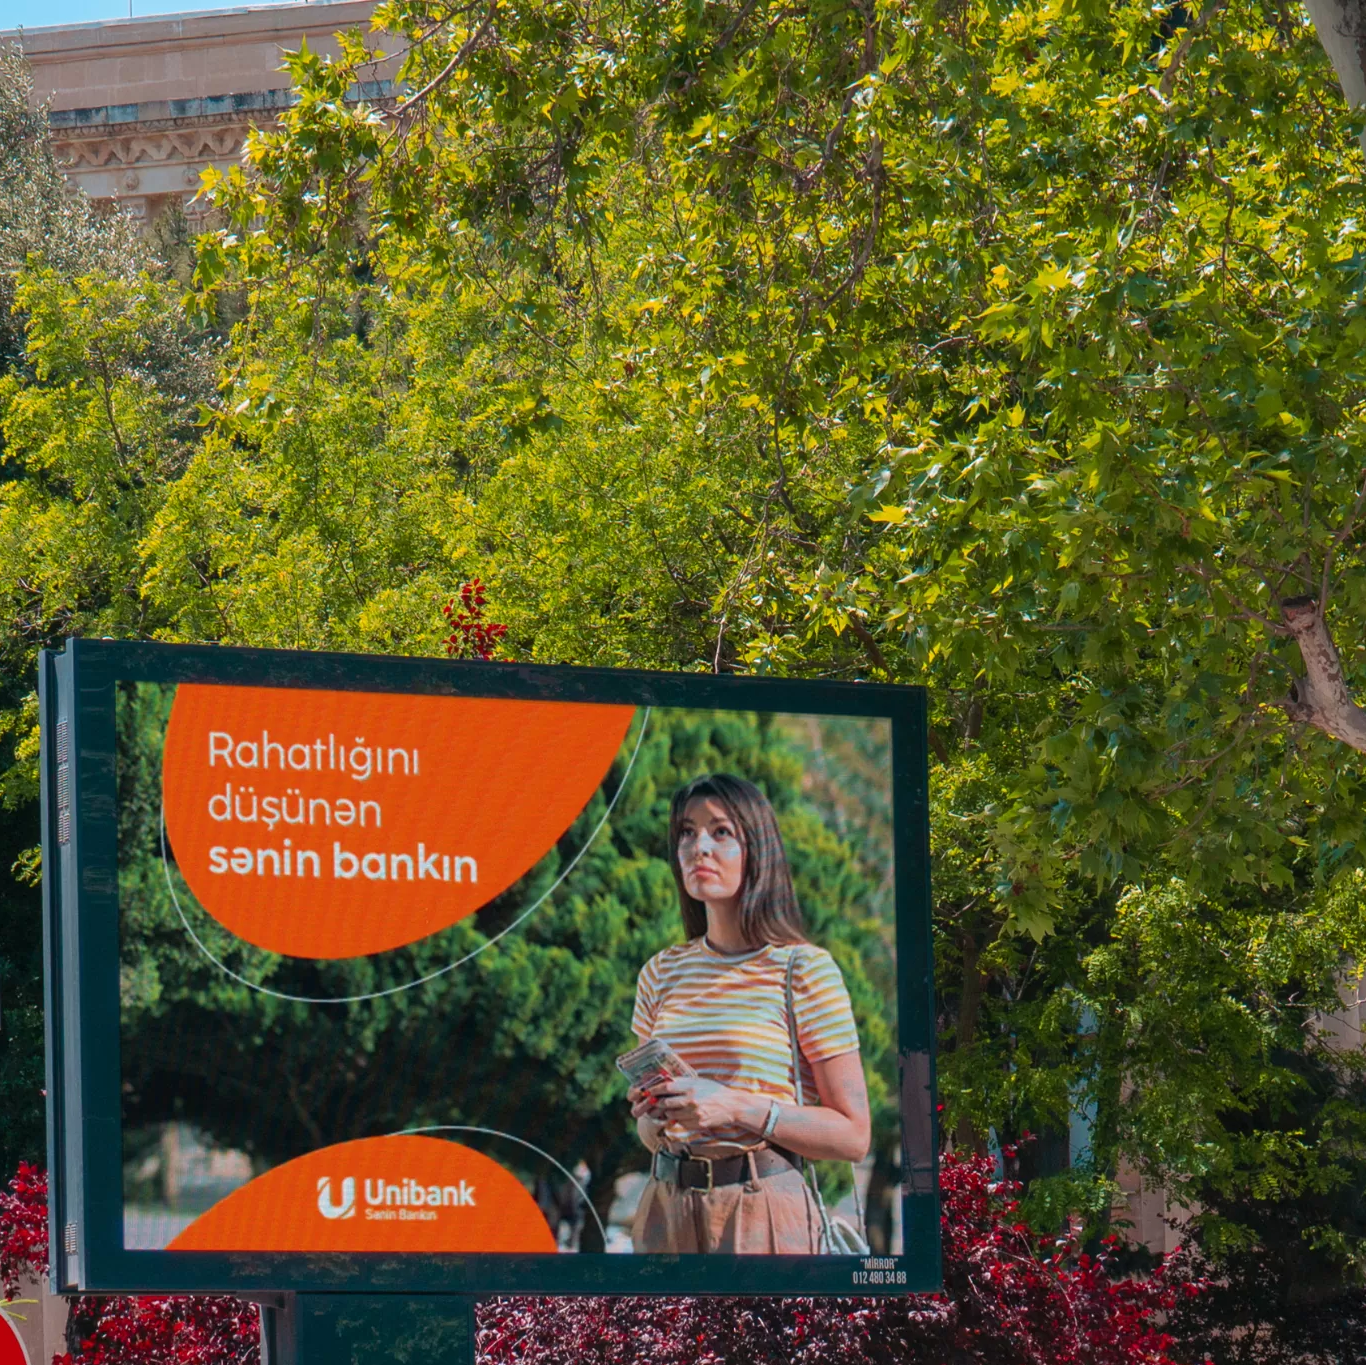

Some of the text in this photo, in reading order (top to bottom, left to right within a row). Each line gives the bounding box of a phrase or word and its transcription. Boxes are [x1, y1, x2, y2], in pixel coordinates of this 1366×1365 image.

[208, 730, 420, 781] Rahatlığını
[208, 782, 382, 831] düşünən
[208, 838, 478, 884] sənin bankın
[364, 1178, 476, 1206] Unibank
[852, 1271, 907, 1284] 012 480 34 88
